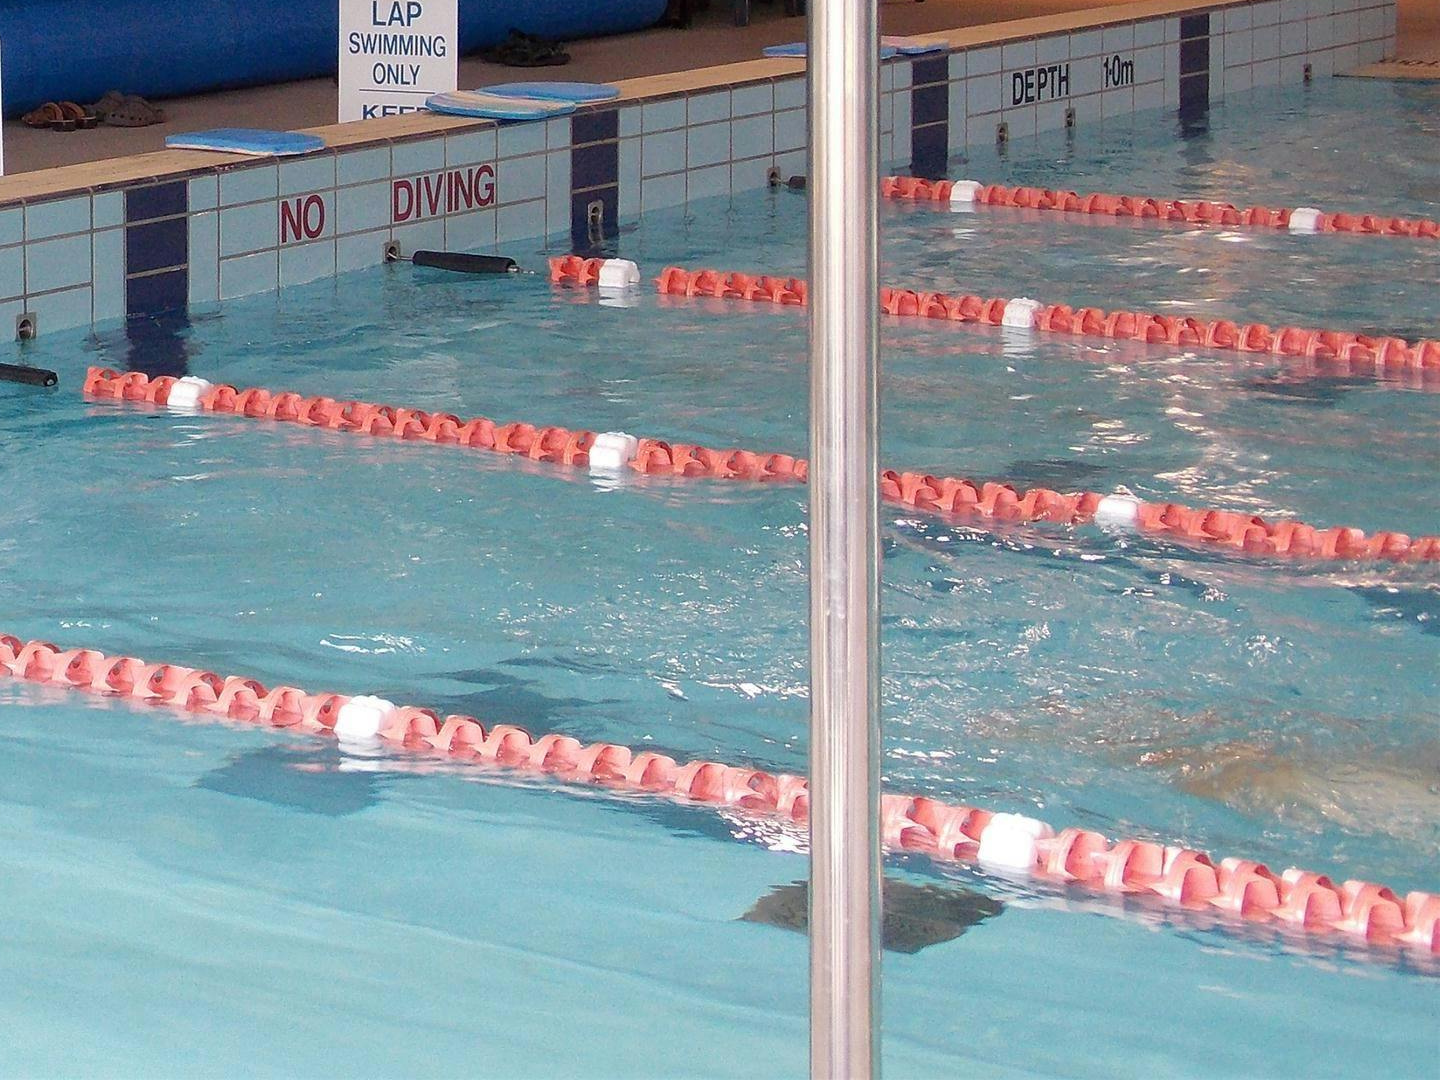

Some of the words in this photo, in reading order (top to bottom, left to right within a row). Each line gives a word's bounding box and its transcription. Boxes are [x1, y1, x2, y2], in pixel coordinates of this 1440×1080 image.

[372, 0, 423, 27] LAP
[349, 32, 446, 58] SWIMMING
[372, 62, 421, 86] ONLY
[1011, 63, 1070, 106] DEPTH
[280, 193, 326, 244] NO
[392, 163, 495, 223] DIVING
